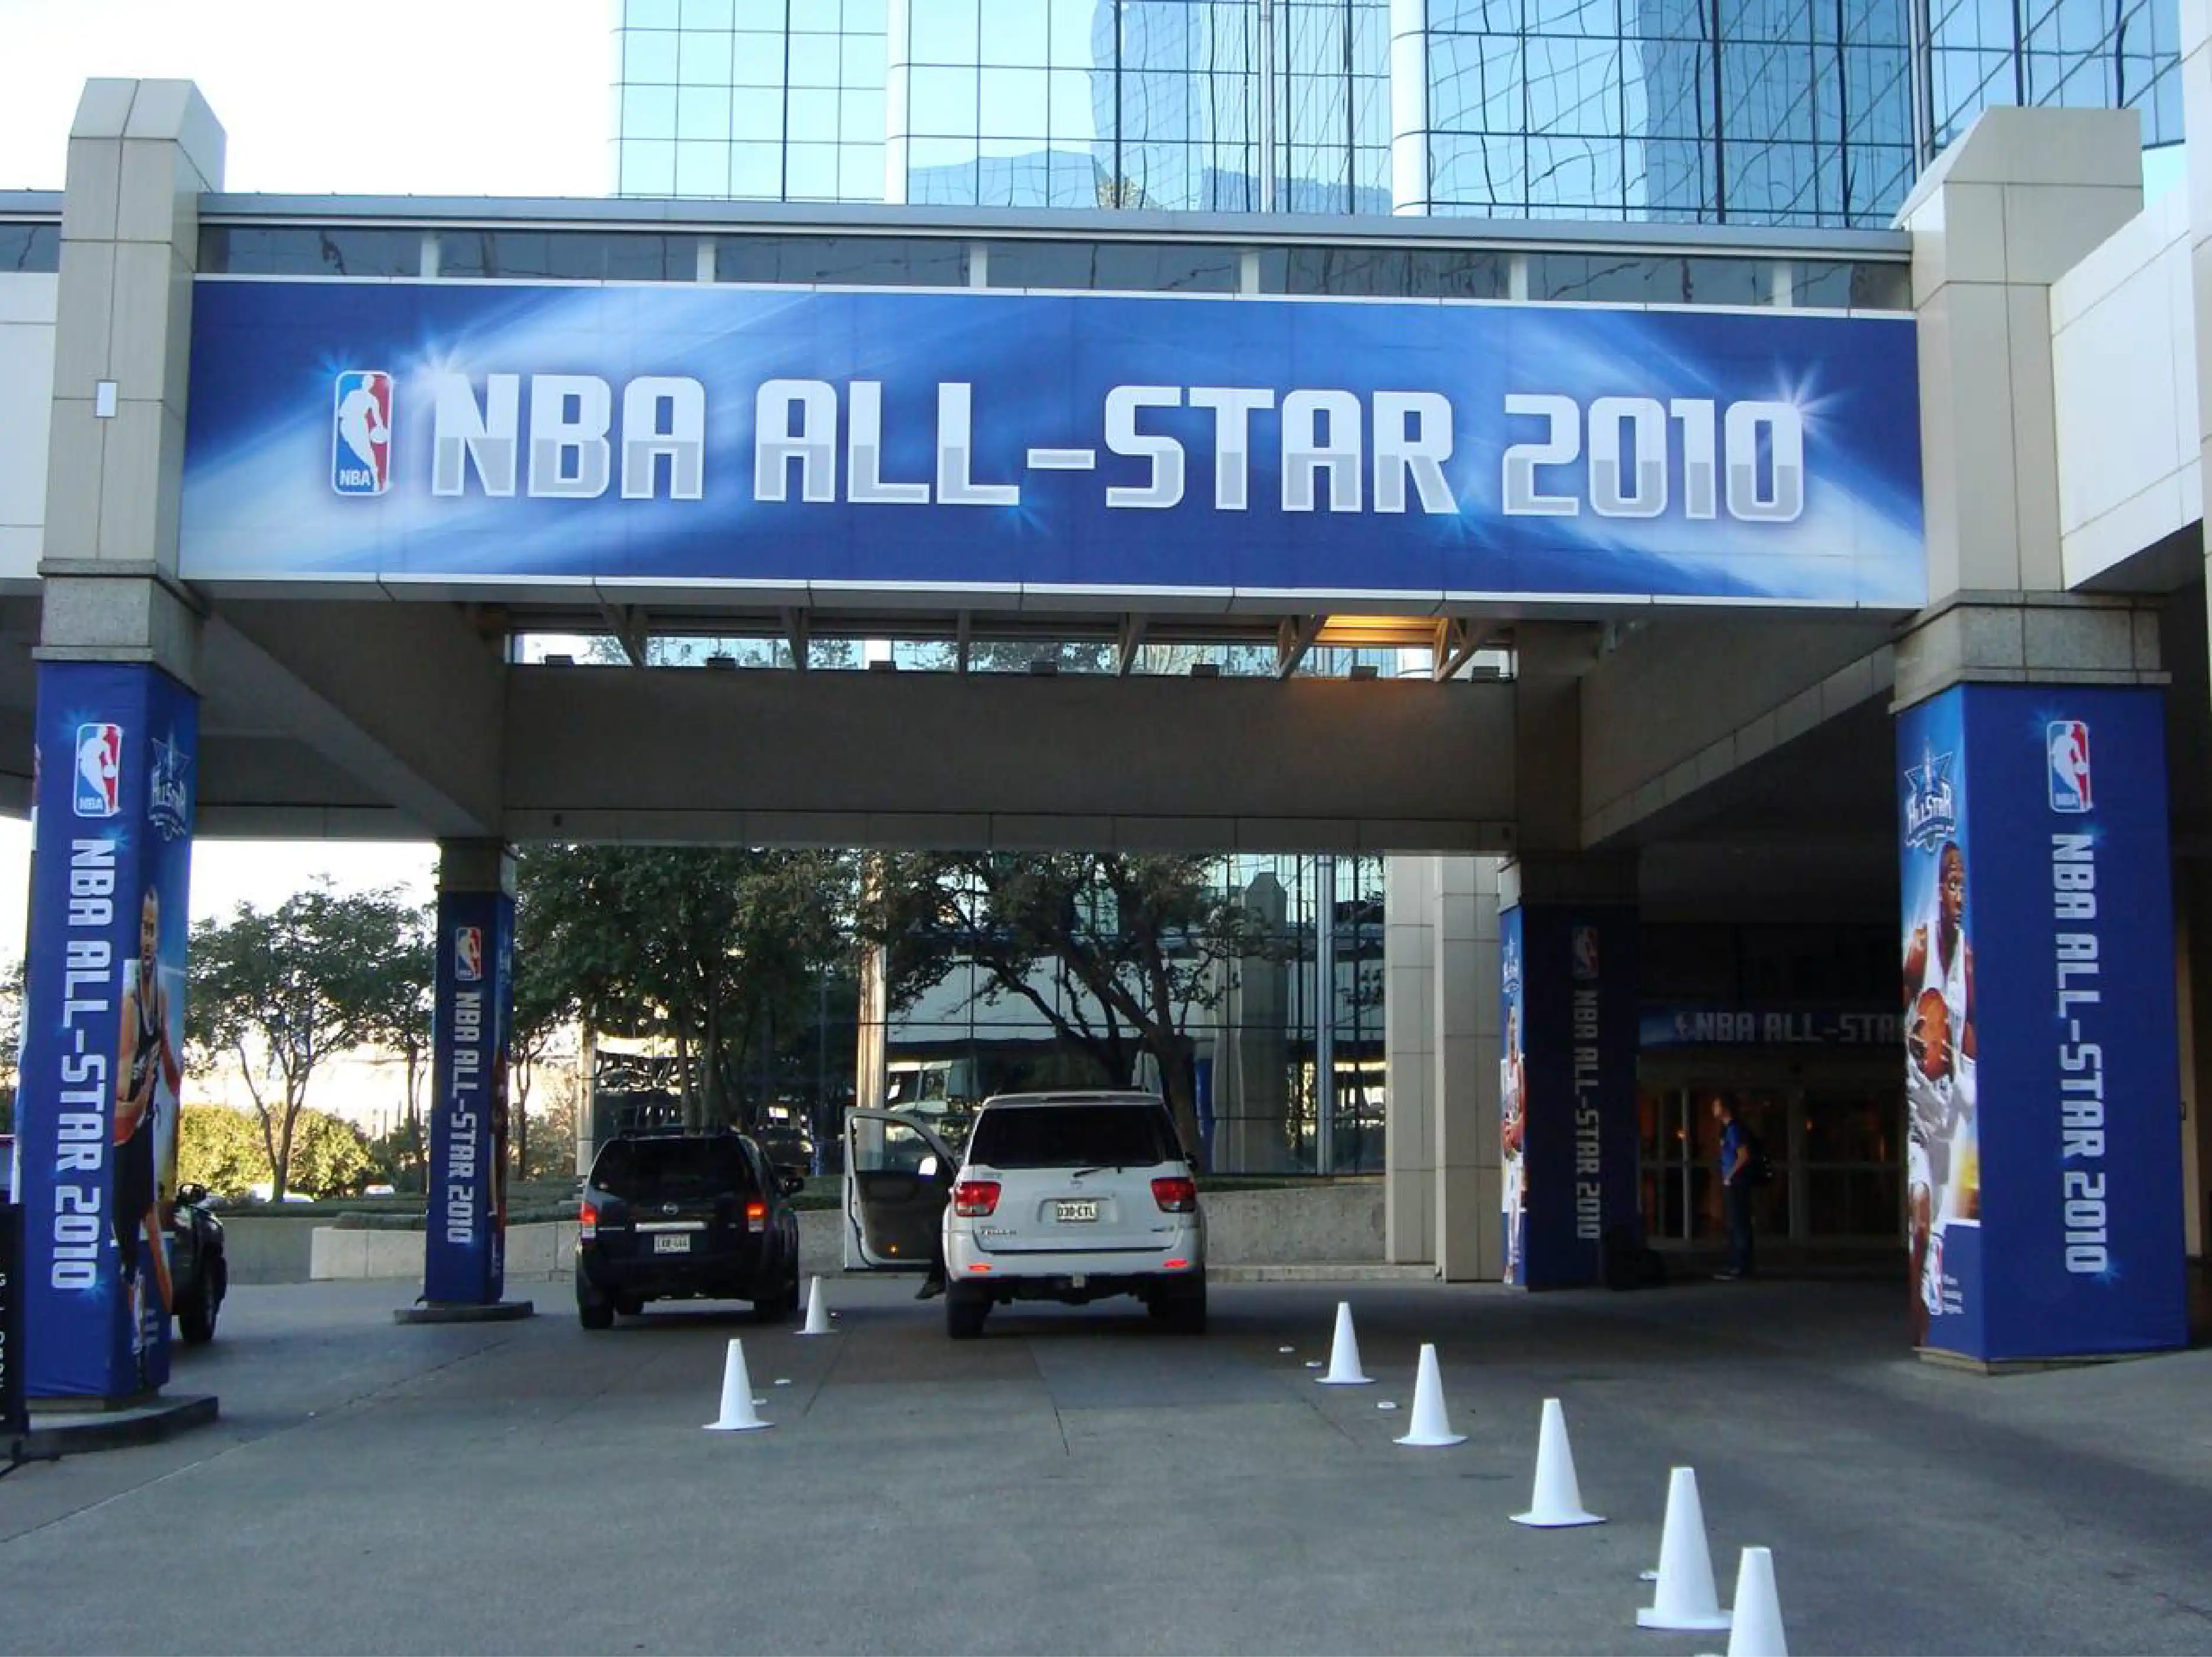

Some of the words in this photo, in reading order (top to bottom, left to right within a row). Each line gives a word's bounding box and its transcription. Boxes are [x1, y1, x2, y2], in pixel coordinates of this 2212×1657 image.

[339, 469, 371, 486] NBA
[431, 373, 705, 500] NBA
[753, 379, 1460, 513] ALL-STAR
[1502, 393, 1804, 522] 2010
[67, 838, 115, 926] NBA
[2052, 834, 2096, 919] NBA
[56, 941, 111, 1171] ALL-STAR
[454, 992, 481, 1041] NBA
[1573, 989, 1599, 1039] NBA
[1694, 1012, 1755, 1042] NBA
[2055, 933, 2105, 1158] ALL-STAR
[448, 1050, 480, 1177] ALL-STAR
[1574, 1047, 1599, 1174] ALL-STAR
[51, 1186, 101, 1290] 2010
[447, 1186, 473, 1244] 2010
[1576, 1182, 1601, 1239] 2010
[2065, 1172, 2108, 1273] 2010
